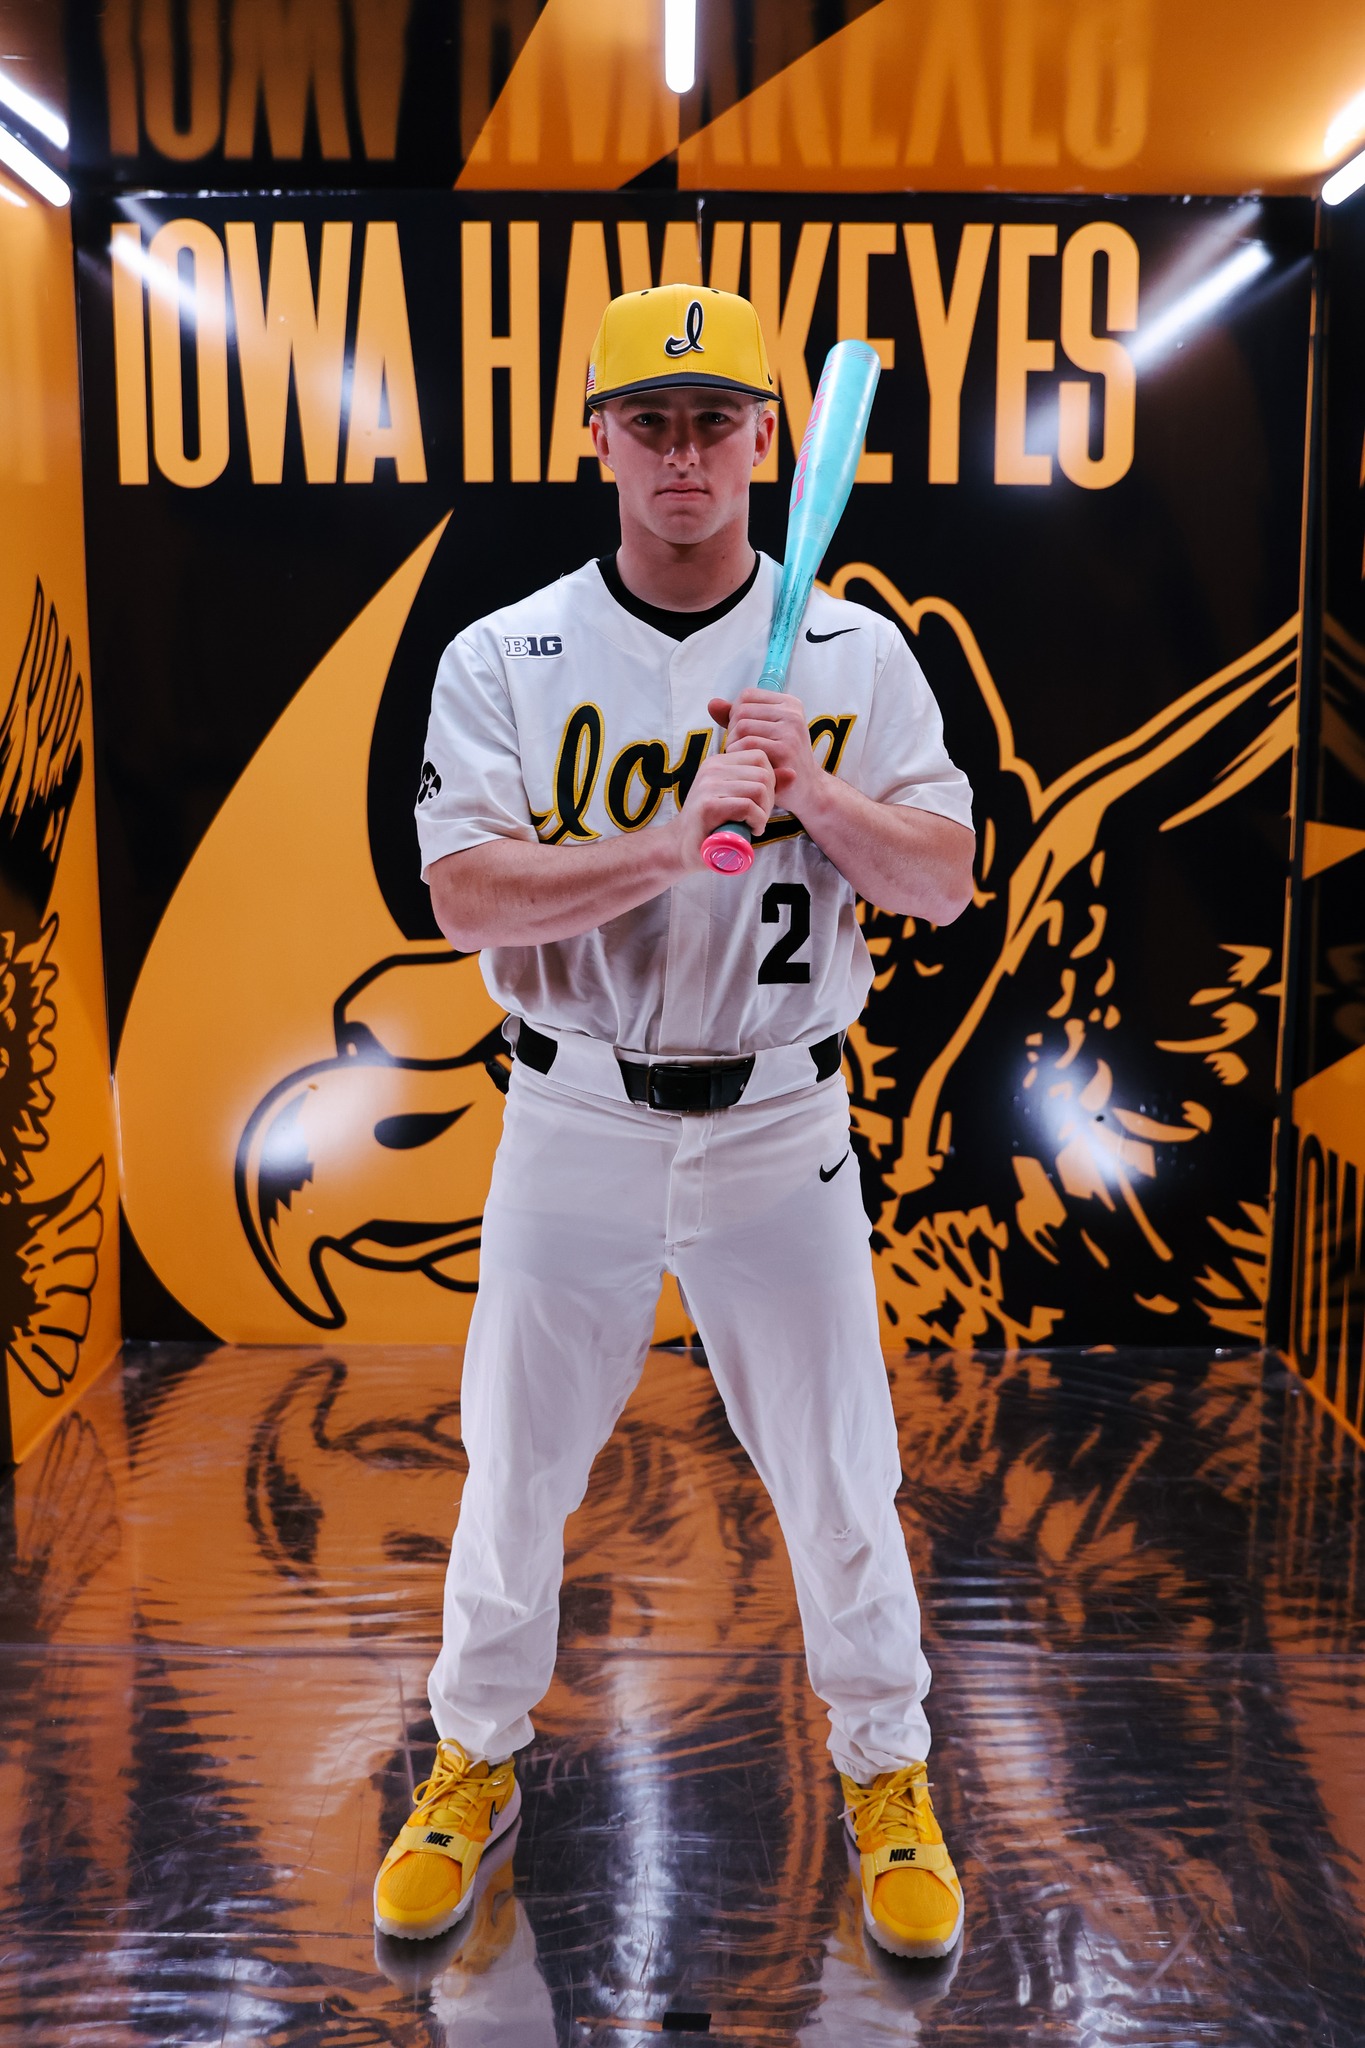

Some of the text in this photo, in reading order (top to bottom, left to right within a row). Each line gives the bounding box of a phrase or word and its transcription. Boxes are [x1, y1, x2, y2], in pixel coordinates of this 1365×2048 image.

[111, 219, 427, 488] IOWA
[757, 882, 811, 985] 2
[424, 1831, 454, 1847] NIKE
[889, 1848, 916, 1862] NIKE
